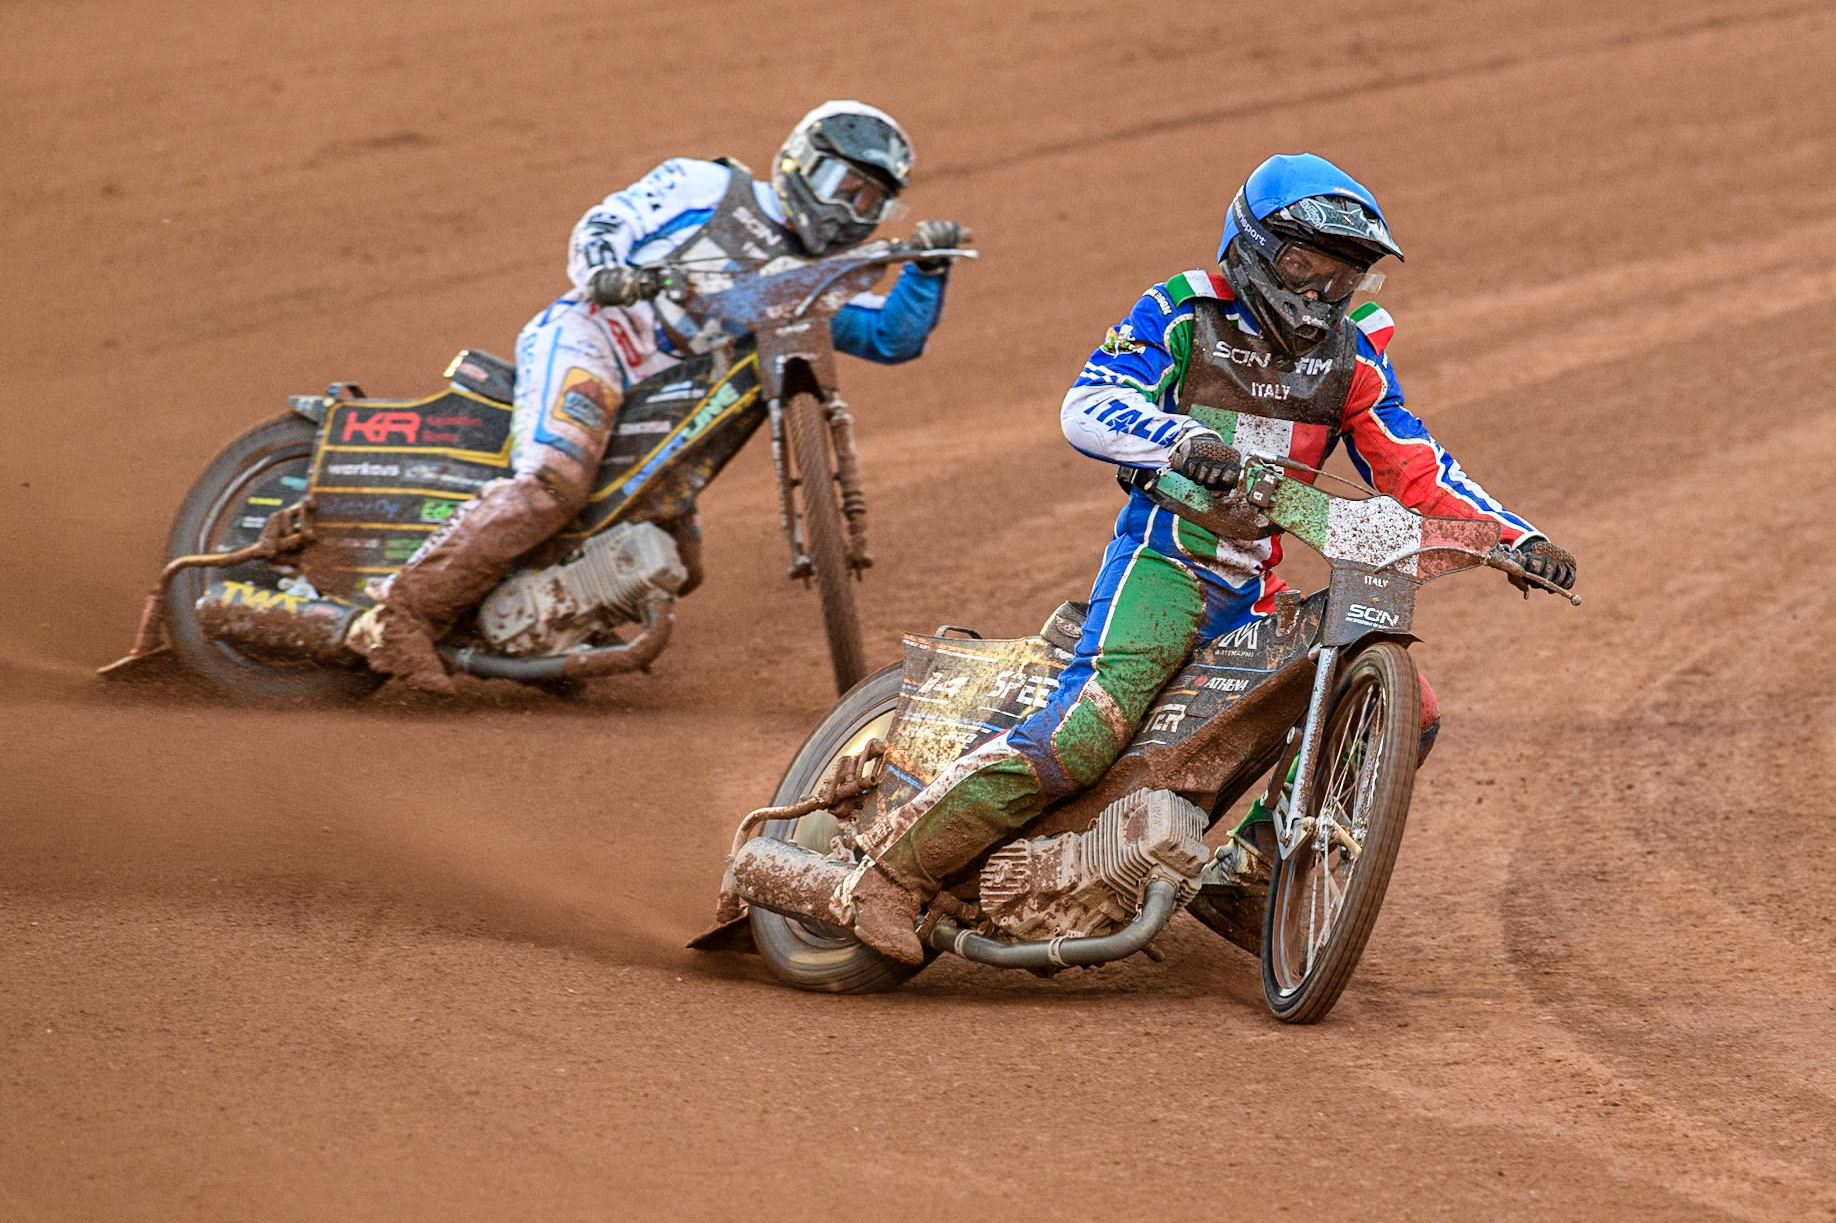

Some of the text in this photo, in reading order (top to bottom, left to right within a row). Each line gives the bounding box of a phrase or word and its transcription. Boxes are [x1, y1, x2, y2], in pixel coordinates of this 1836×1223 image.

[1212, 341, 1333, 375] SON FIM
[1251, 381, 1291, 400] ITALY
[1364, 575, 1389, 588] ITALY
[1347, 603, 1399, 627] SON
[1204, 676, 1249, 692] ATHENA
